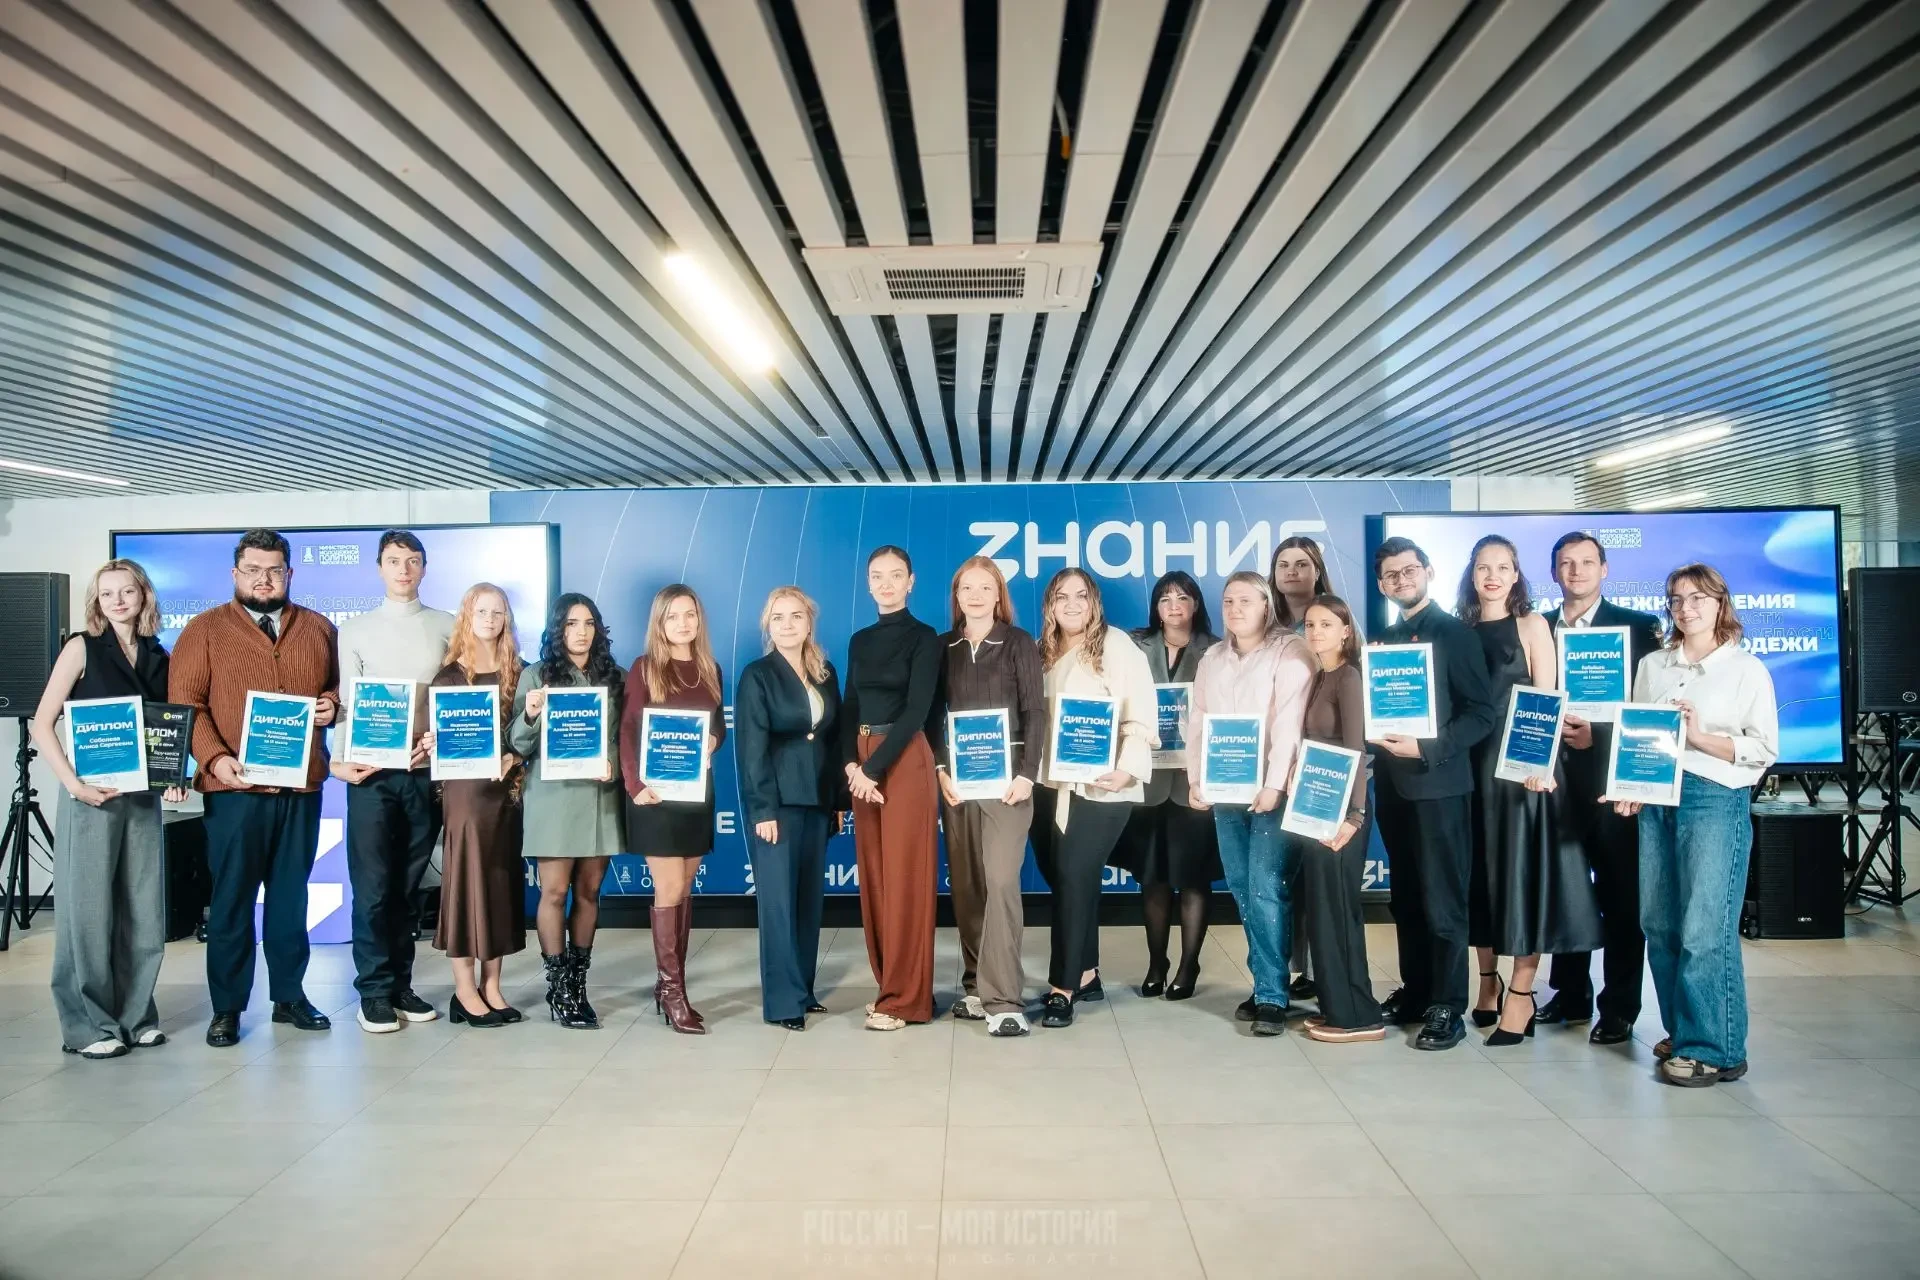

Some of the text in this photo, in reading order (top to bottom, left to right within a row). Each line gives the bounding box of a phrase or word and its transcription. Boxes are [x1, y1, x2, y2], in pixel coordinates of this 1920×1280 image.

[1602, 582, 1664, 594] ОБЛАС
[321, 597, 385, 609] ОБЛАС
[1733, 594, 1795, 609] ЕМИЯ
[1739, 612, 1784, 624] АСТИ
[1740, 637, 1818, 655] ОДЕЖИ
[1567, 652, 1620, 660] ДИПЛОМ
[1372, 667, 1424, 678] ДИПЛОМ
[358, 700, 407, 708] ДИПЛОМ
[440, 709, 490, 718] ДИПЛОМ
[550, 710, 598, 719] ДИПЛОМ
[1515, 710, 1556, 723] ДИПЛОМ
[253, 715, 304, 727] ДИПЛОМ
[1063, 716, 1110, 725] ДИПЛОМ
[76, 721, 133, 734] ДИПЛОМ
[145, 728, 177, 738] ПЛОМ
[651, 732, 700, 740] ДИПЛОМ
[958, 732, 1001, 742] ДИПЛОМ
[1304, 765, 1347, 780] ДИПЛОМ
